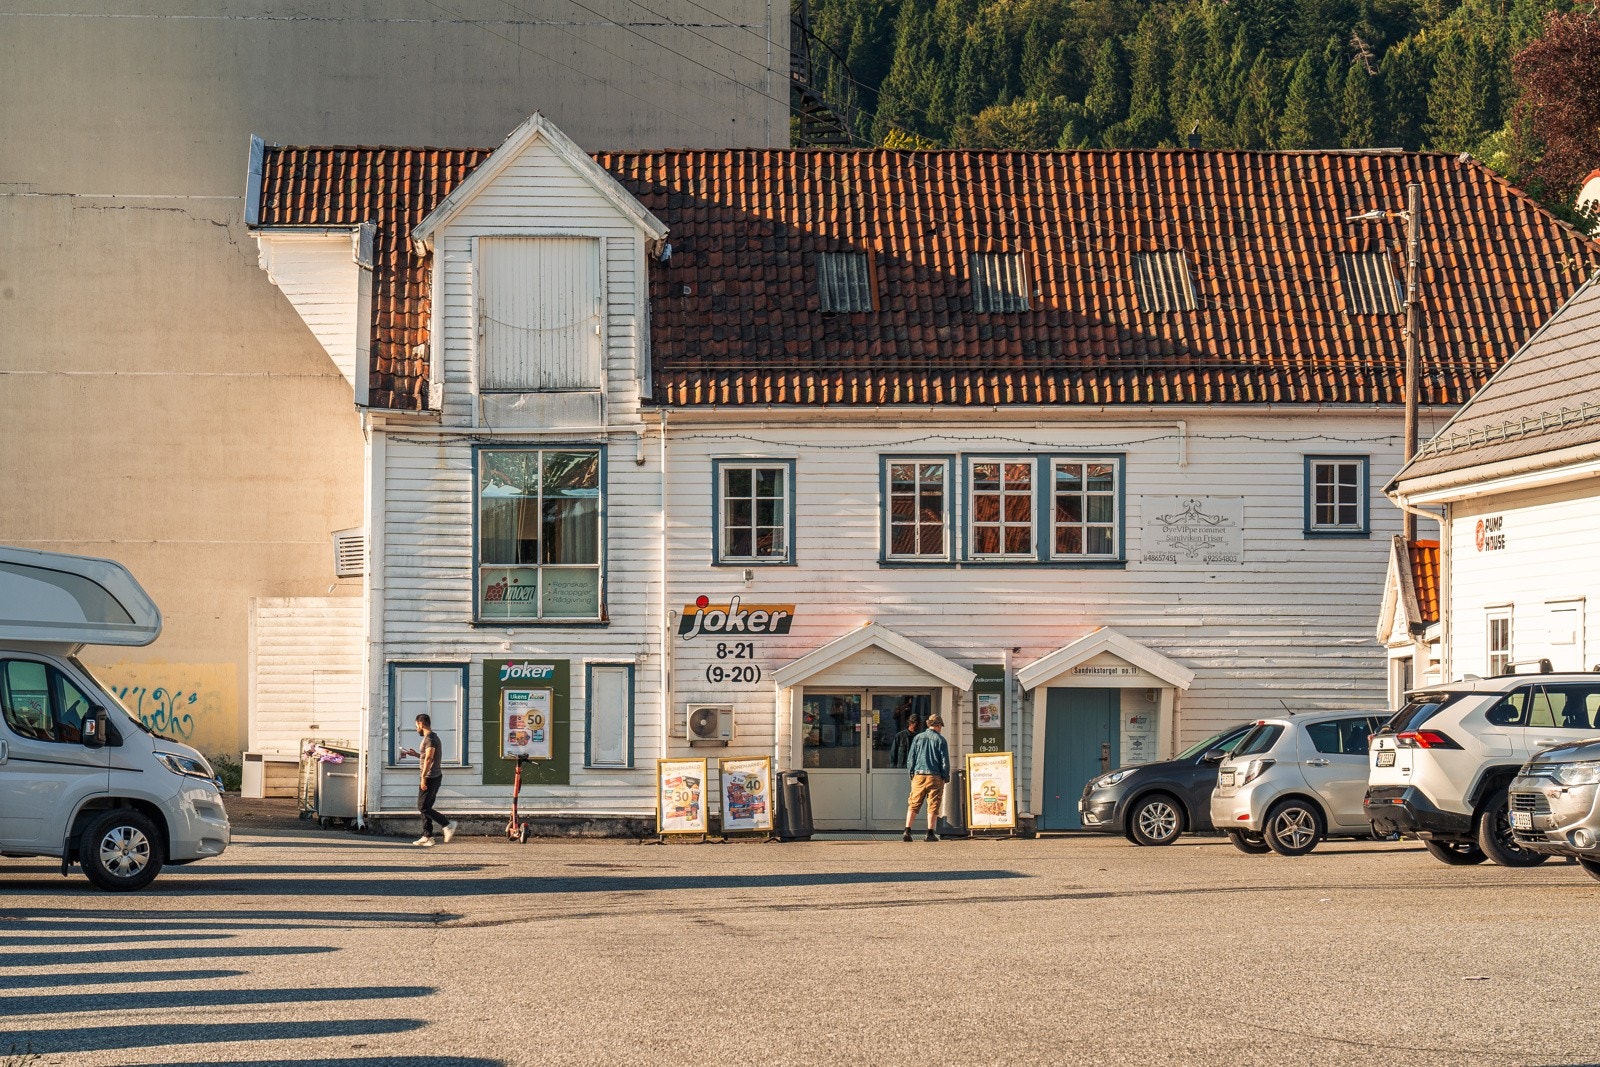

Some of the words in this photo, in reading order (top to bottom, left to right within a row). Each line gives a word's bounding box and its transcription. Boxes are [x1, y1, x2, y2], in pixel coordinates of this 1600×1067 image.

[1485, 516, 1503, 533] PUMP
[1166, 534, 1202, 542] Sandviken
[1203, 534, 1224, 542] Frisør
[1485, 534, 1506, 552] HOUSE
[552, 581, 588, 589] Regnskap
[552, 596, 592, 604] Rådgivning
[683, 594, 787, 641] joker
[716, 642, 754, 660] 8-21
[500, 661, 551, 682] joker
[705, 664, 761, 684] (9-20)
[1074, 666, 1118, 675] Sandvikstorget
[527, 714, 542, 725] 50
[745, 780, 761, 791] 40
[674, 791, 689, 802] 30
[983, 786, 996, 797] 25
